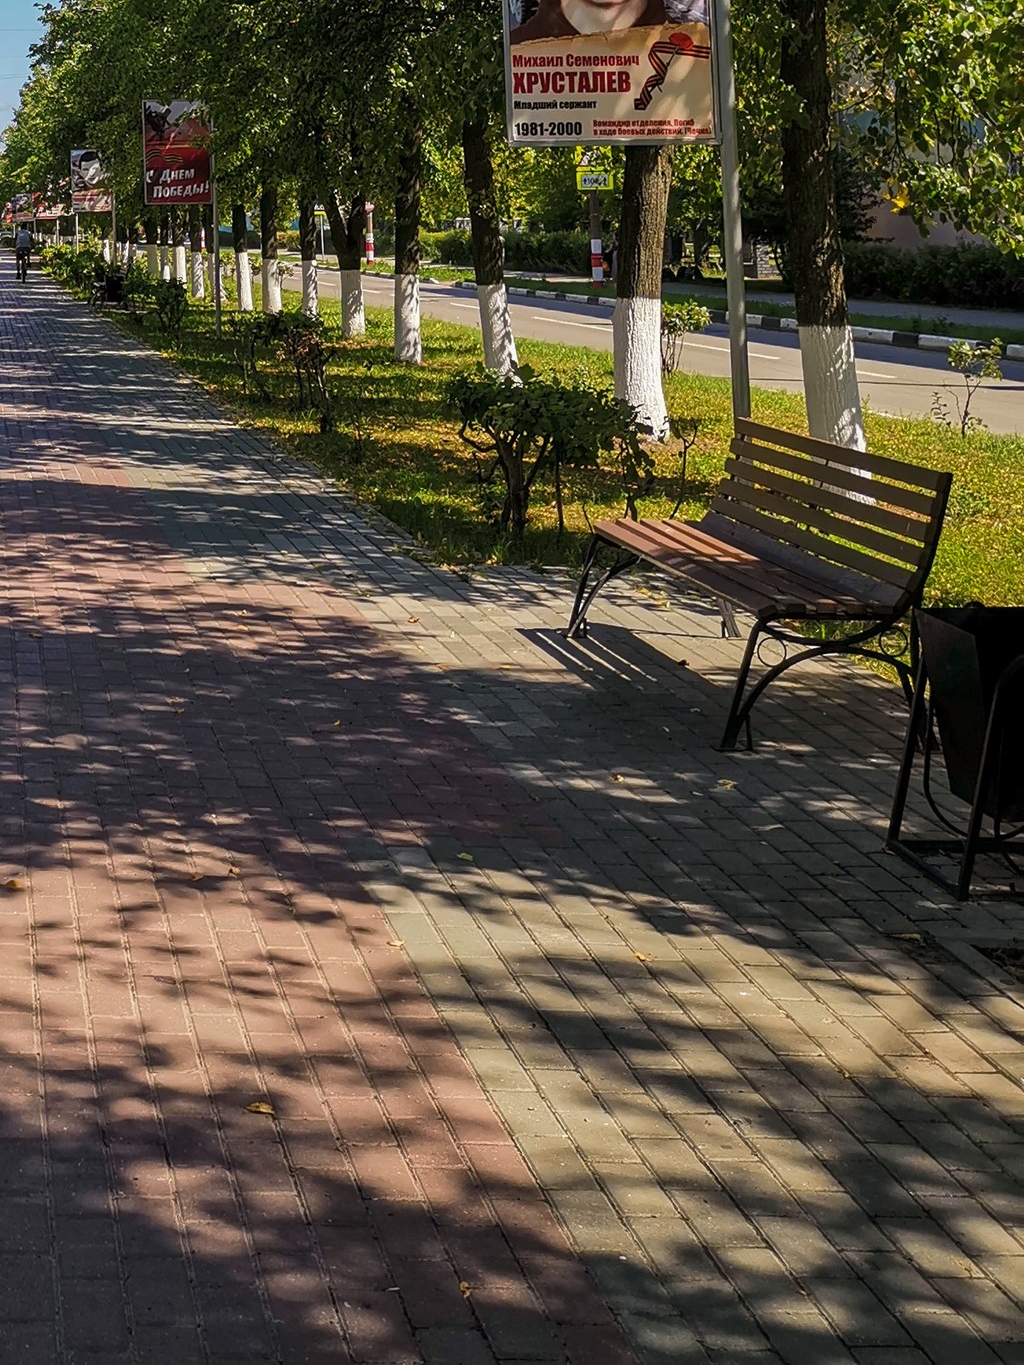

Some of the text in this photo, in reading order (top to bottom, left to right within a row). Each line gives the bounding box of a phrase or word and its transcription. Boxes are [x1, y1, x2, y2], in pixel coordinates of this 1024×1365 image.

[513, 53, 639, 67] Михаил Семенович
[513, 71, 631, 94] ХРУСТАЛЕВ
[514, 100, 597, 110] Младший сержант
[514, 121, 582, 136] 1981-2000
